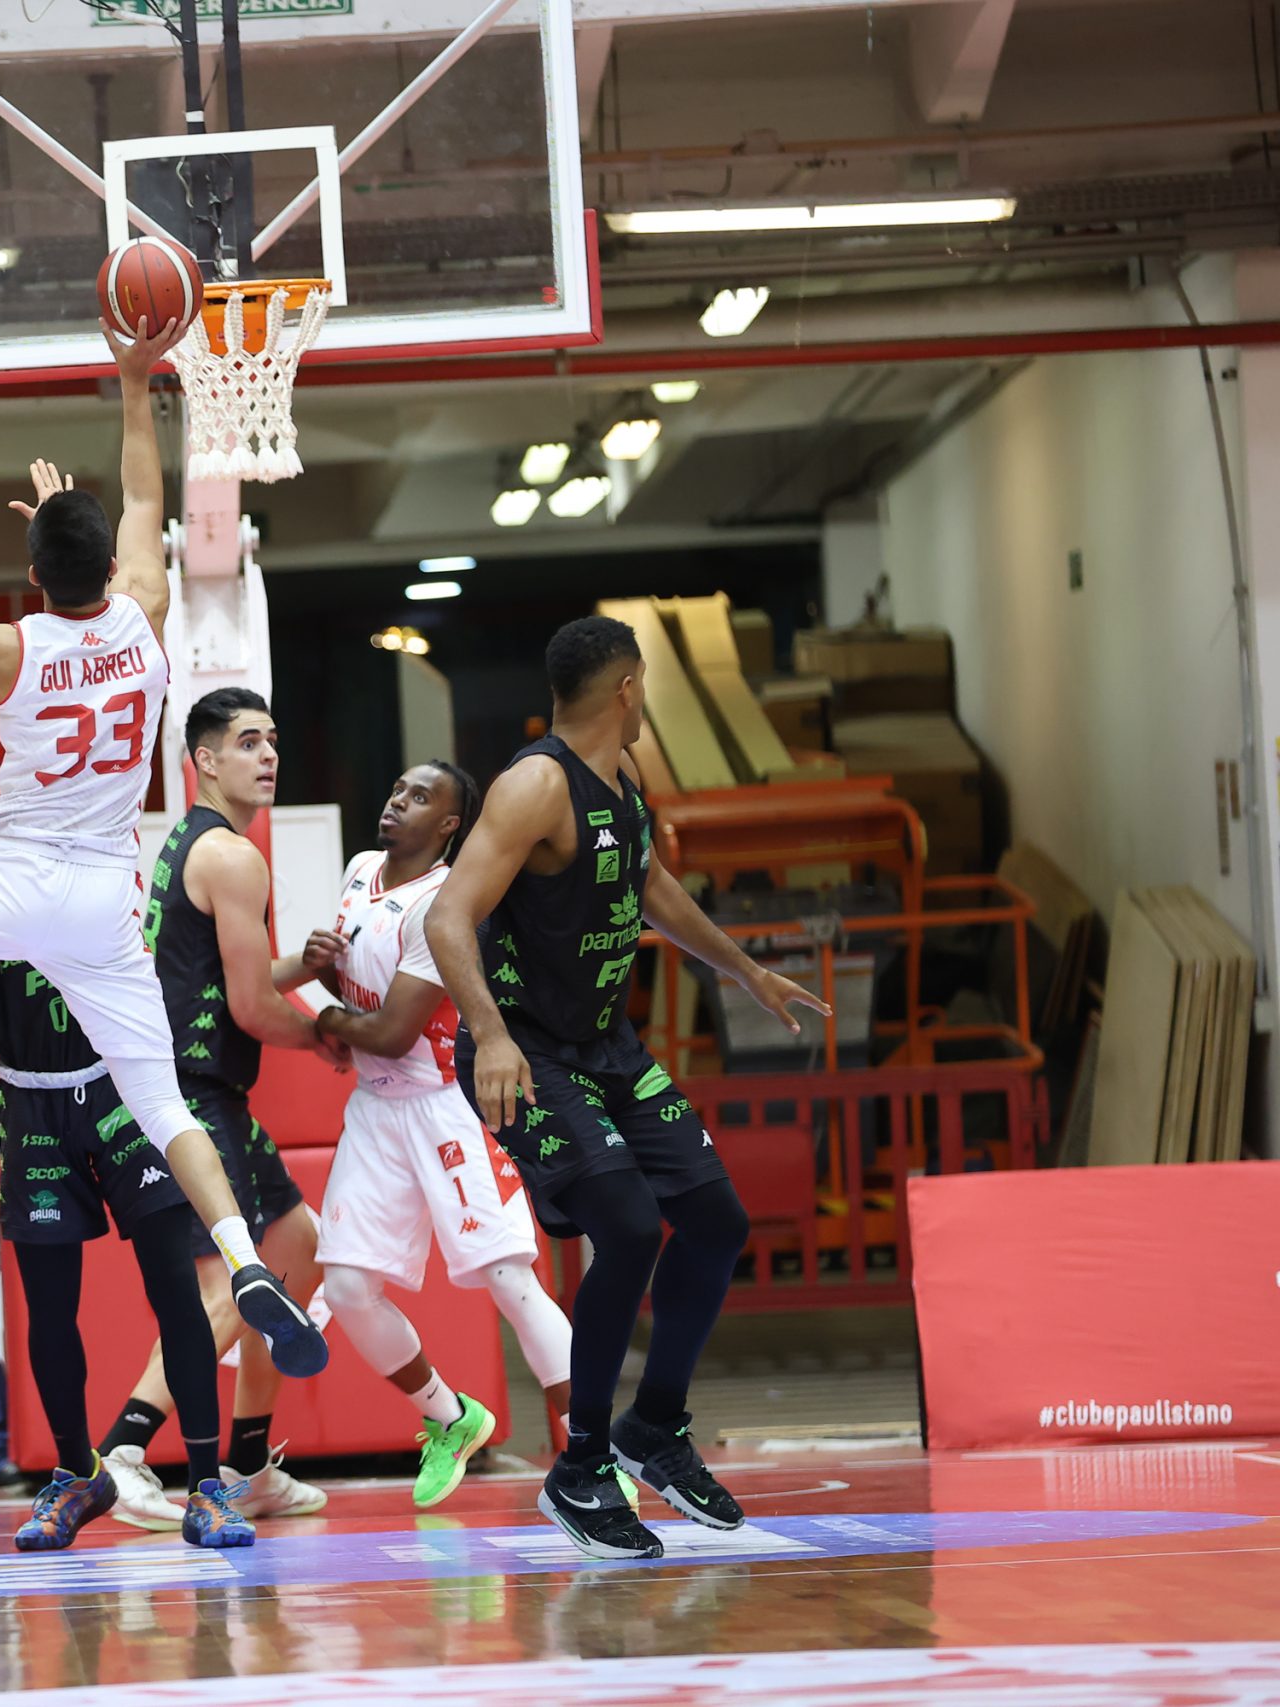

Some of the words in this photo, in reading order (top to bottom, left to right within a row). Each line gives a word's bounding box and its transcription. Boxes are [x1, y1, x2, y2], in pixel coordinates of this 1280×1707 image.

[41, 660, 73, 693] GUI
[80, 646, 146, 687] ABREU
[35, 689, 146, 787] 33
[453, 1176, 468, 1208] 1
[29, 1208, 61, 1222] BAURU
[1039, 1399, 1233, 1432] #clubepaulistano
